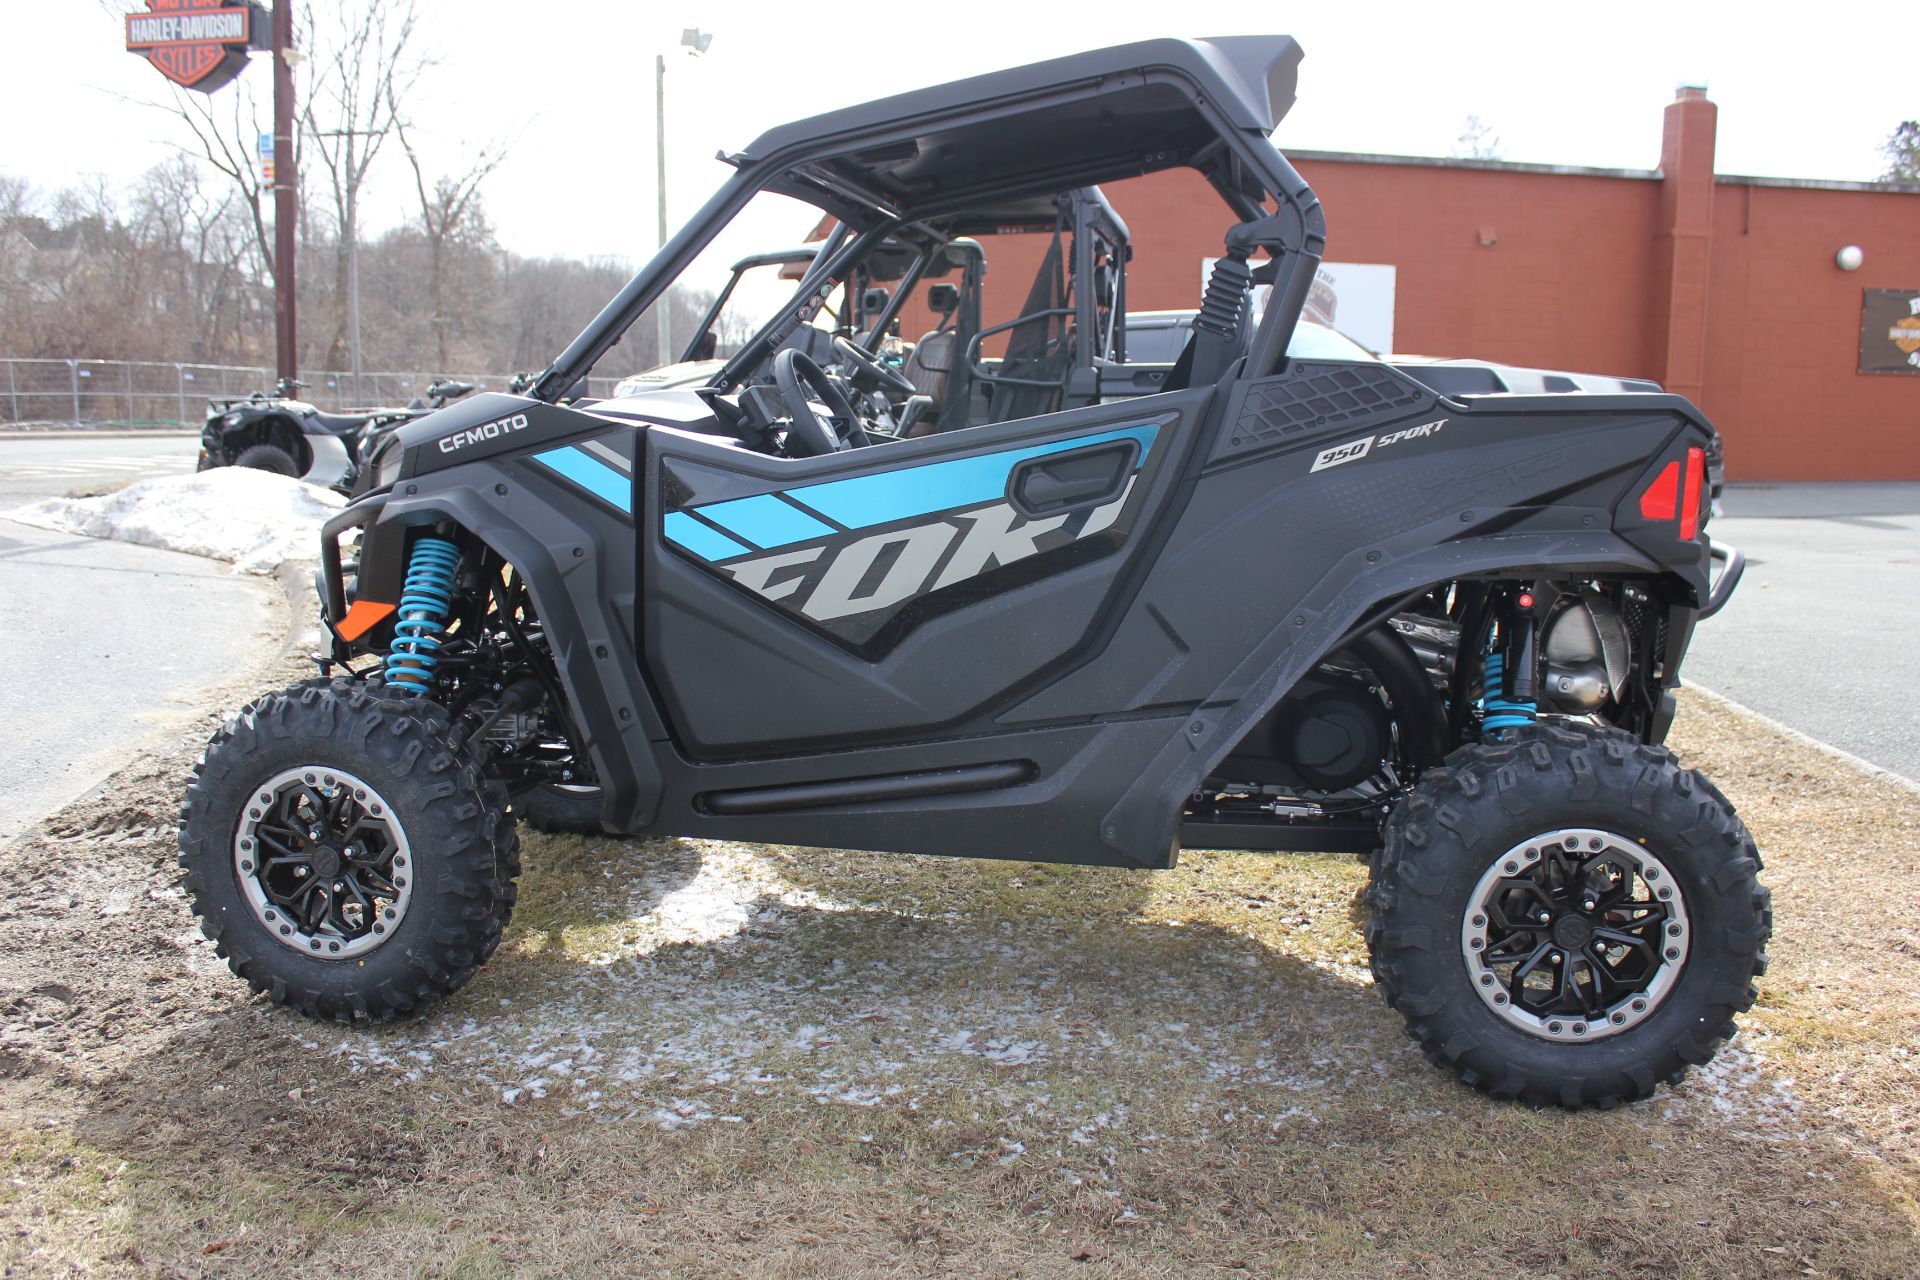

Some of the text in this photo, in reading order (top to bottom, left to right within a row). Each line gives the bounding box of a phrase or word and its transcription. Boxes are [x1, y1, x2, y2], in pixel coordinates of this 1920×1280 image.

[130, 13, 243, 43] HARLEY-DAVIDSON
[157, 45, 215, 78] CYCLES
[438, 413, 529, 453] CFMOTO
[1320, 418, 1449, 465] 950 SPORT
